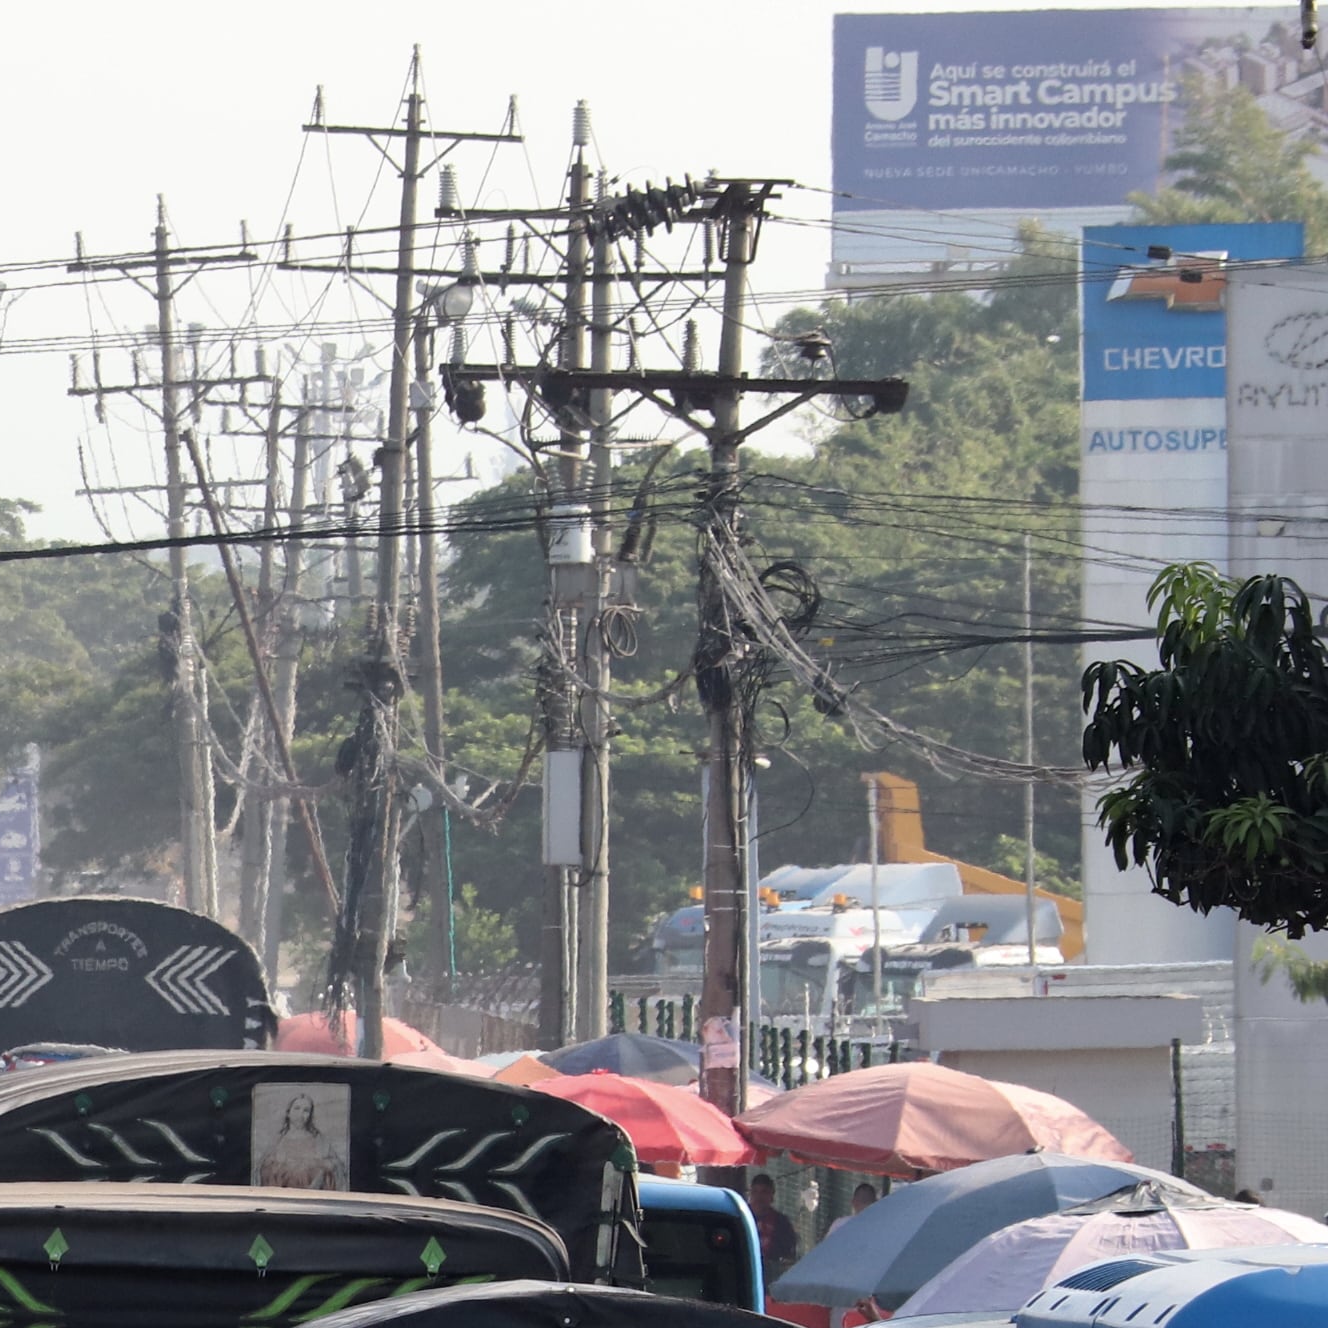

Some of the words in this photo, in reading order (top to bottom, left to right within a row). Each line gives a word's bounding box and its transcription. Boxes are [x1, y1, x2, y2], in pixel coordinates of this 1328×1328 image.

[930, 62, 978, 82] Aquí
[983, 66, 1004, 79] se
[1011, 60, 1110, 78] construirá
[1117, 60, 1136, 76] el
[929, 80, 1031, 106] Smart
[1037, 80, 1178, 107] Campus
[929, 109, 985, 130] más
[990, 107, 1126, 129] innovador
[928, 134, 951, 148] del
[954, 134, 1042, 146] suroccidente
[1045, 132, 1127, 146] colombiano
[865, 167, 912, 178] NUEVA
[917, 166, 954, 178] SEDE
